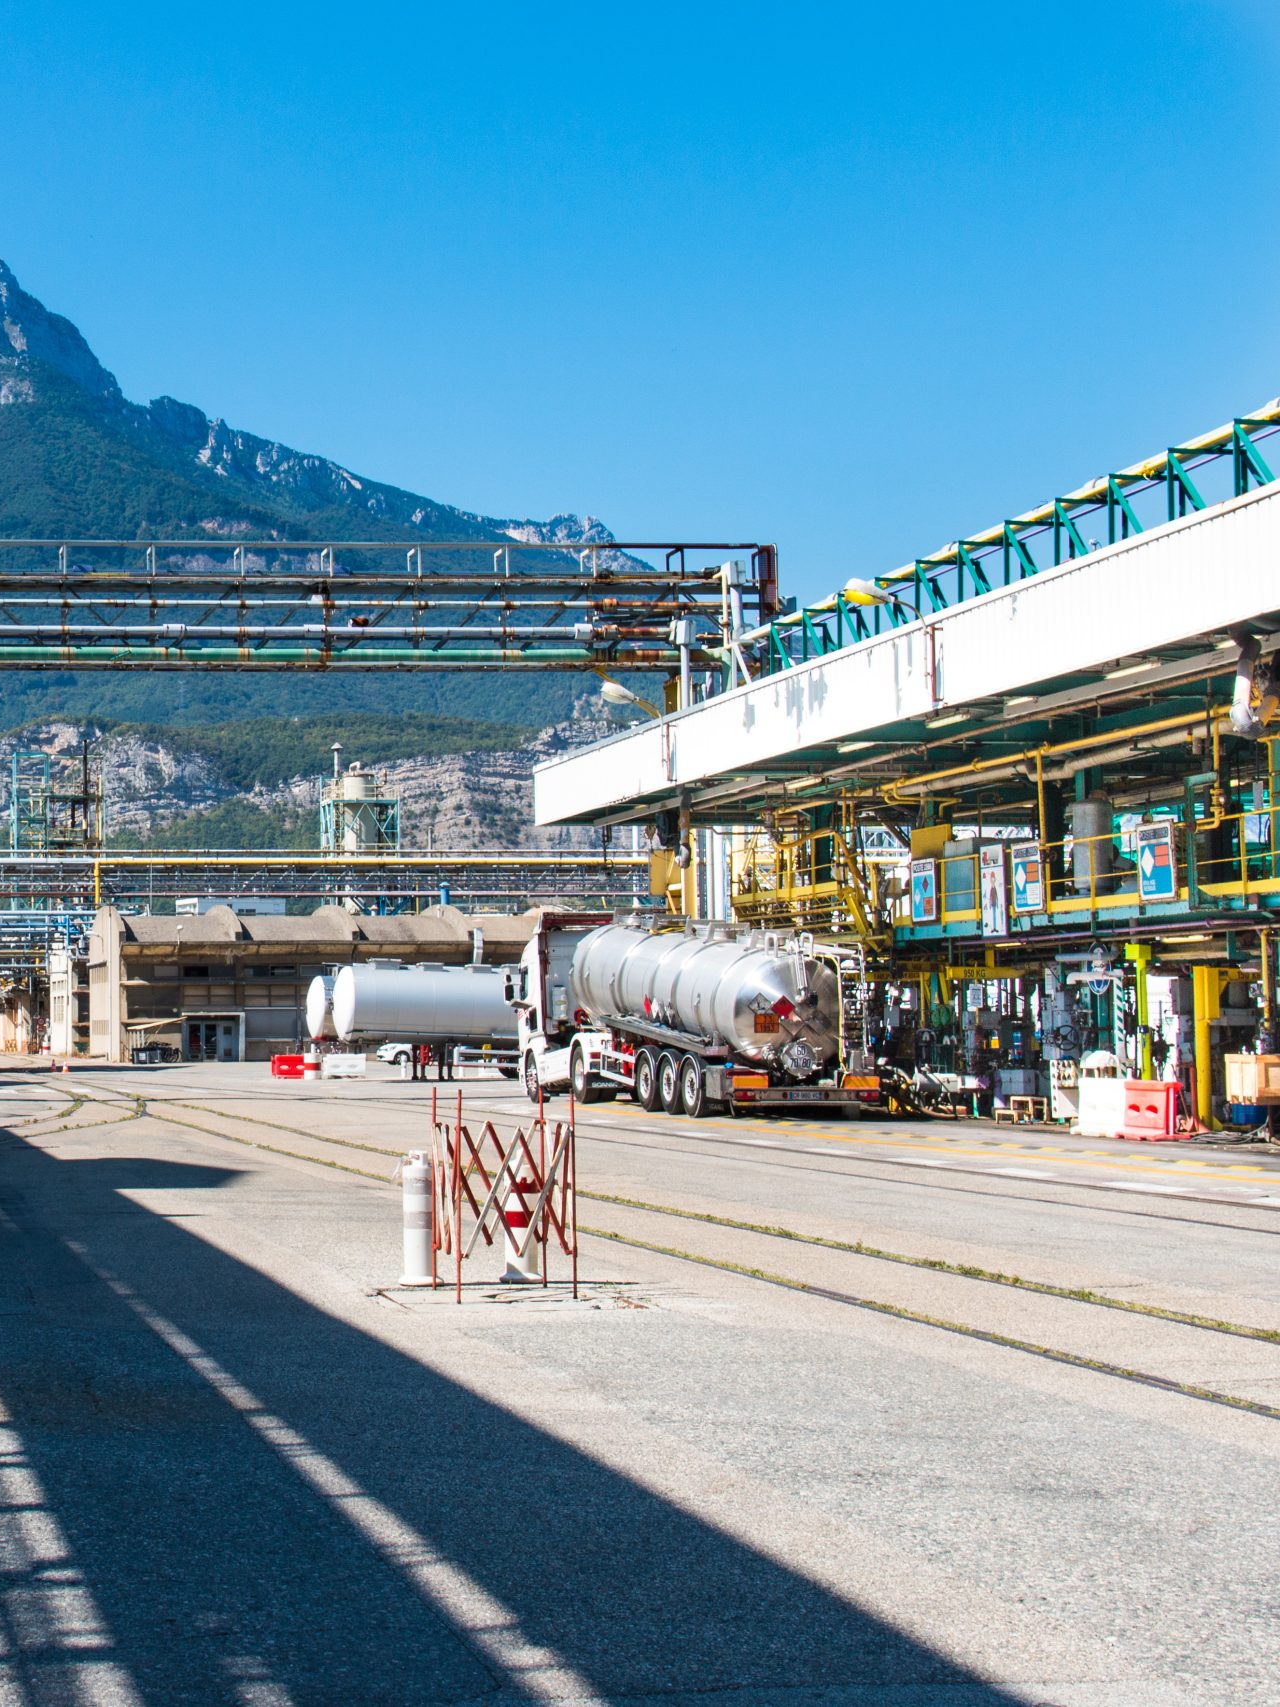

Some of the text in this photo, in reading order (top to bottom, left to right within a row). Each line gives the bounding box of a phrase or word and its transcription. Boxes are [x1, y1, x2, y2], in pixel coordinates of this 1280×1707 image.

[963, 968, 986, 978] 950 KG
[796, 1045, 806, 1056] 60
[790, 1057, 811, 1068] 70 80
